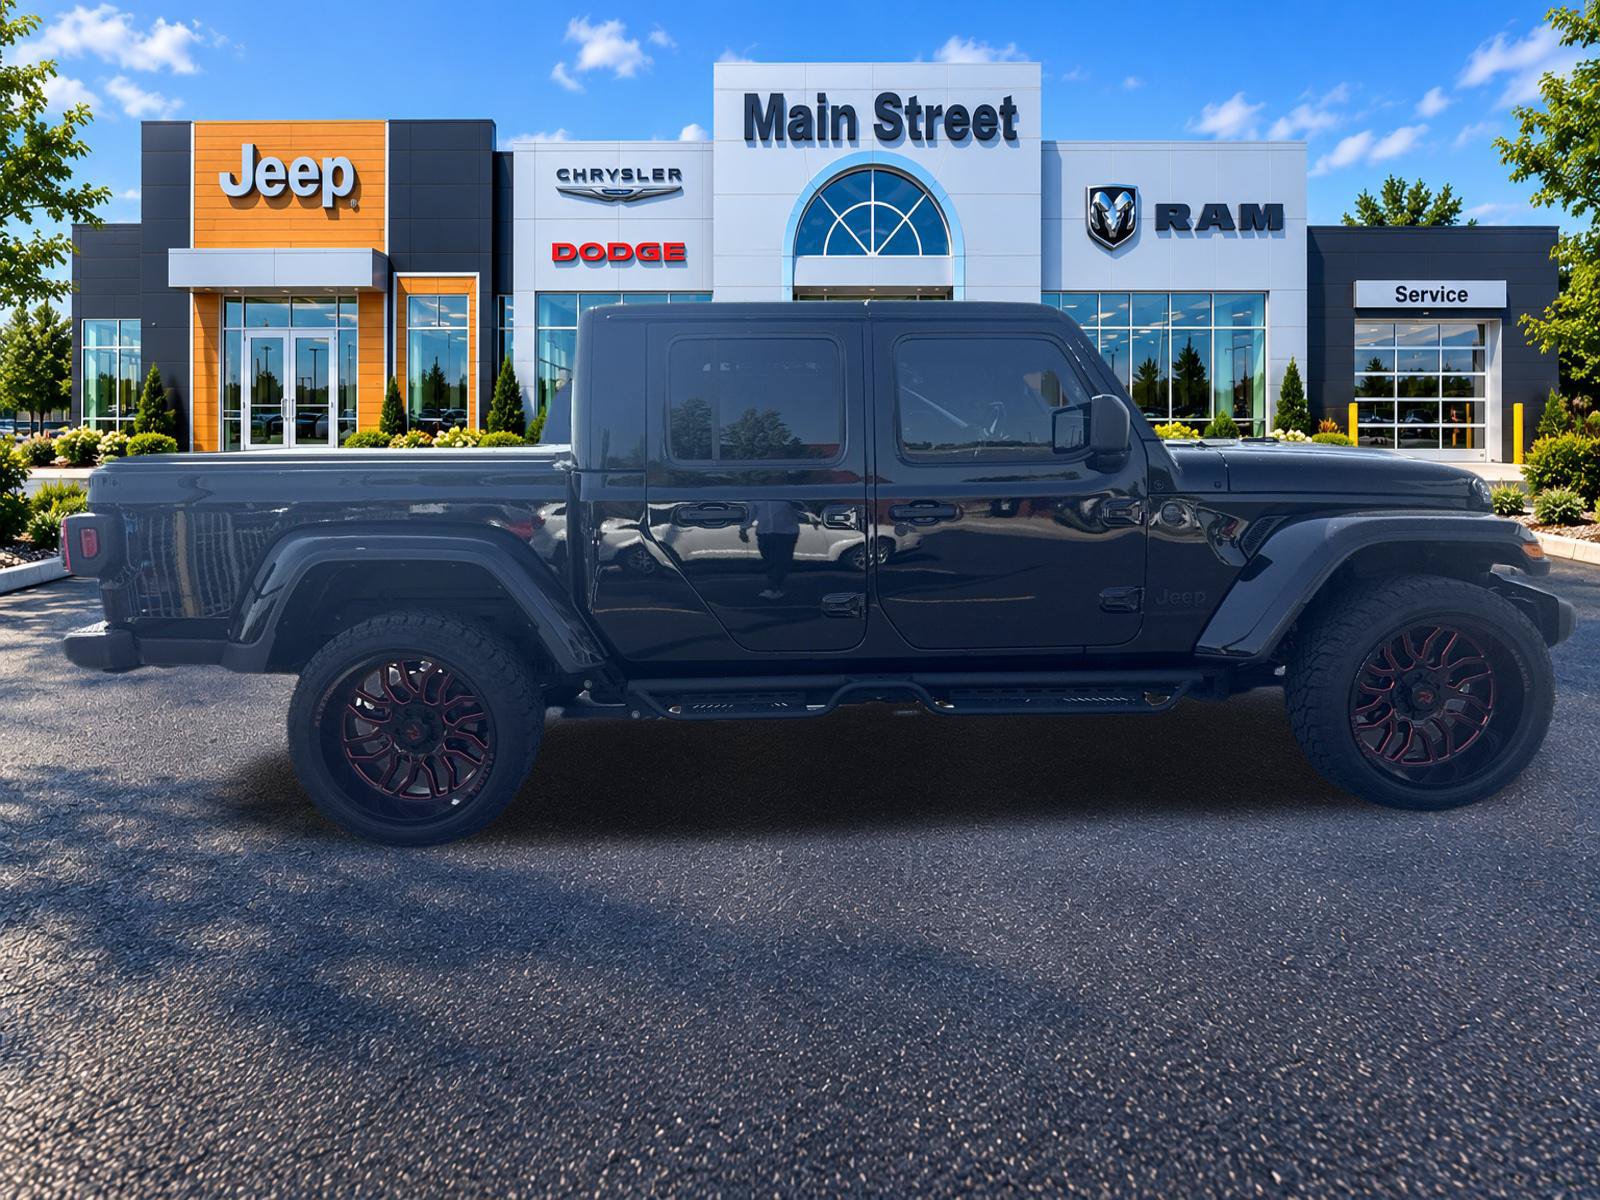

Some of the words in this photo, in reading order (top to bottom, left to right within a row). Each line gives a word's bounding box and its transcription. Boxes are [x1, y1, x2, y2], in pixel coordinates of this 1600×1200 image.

[743, 92, 857, 141] Main
[873, 91, 1018, 142] Street
[218, 143, 356, 209] Jeep
[556, 167, 683, 182] CHRYSLER
[1155, 203, 1284, 232] RAM
[551, 242, 687, 262] DODGE
[1395, 285, 1469, 303] Service
[1154, 588, 1207, 608] Jeep
